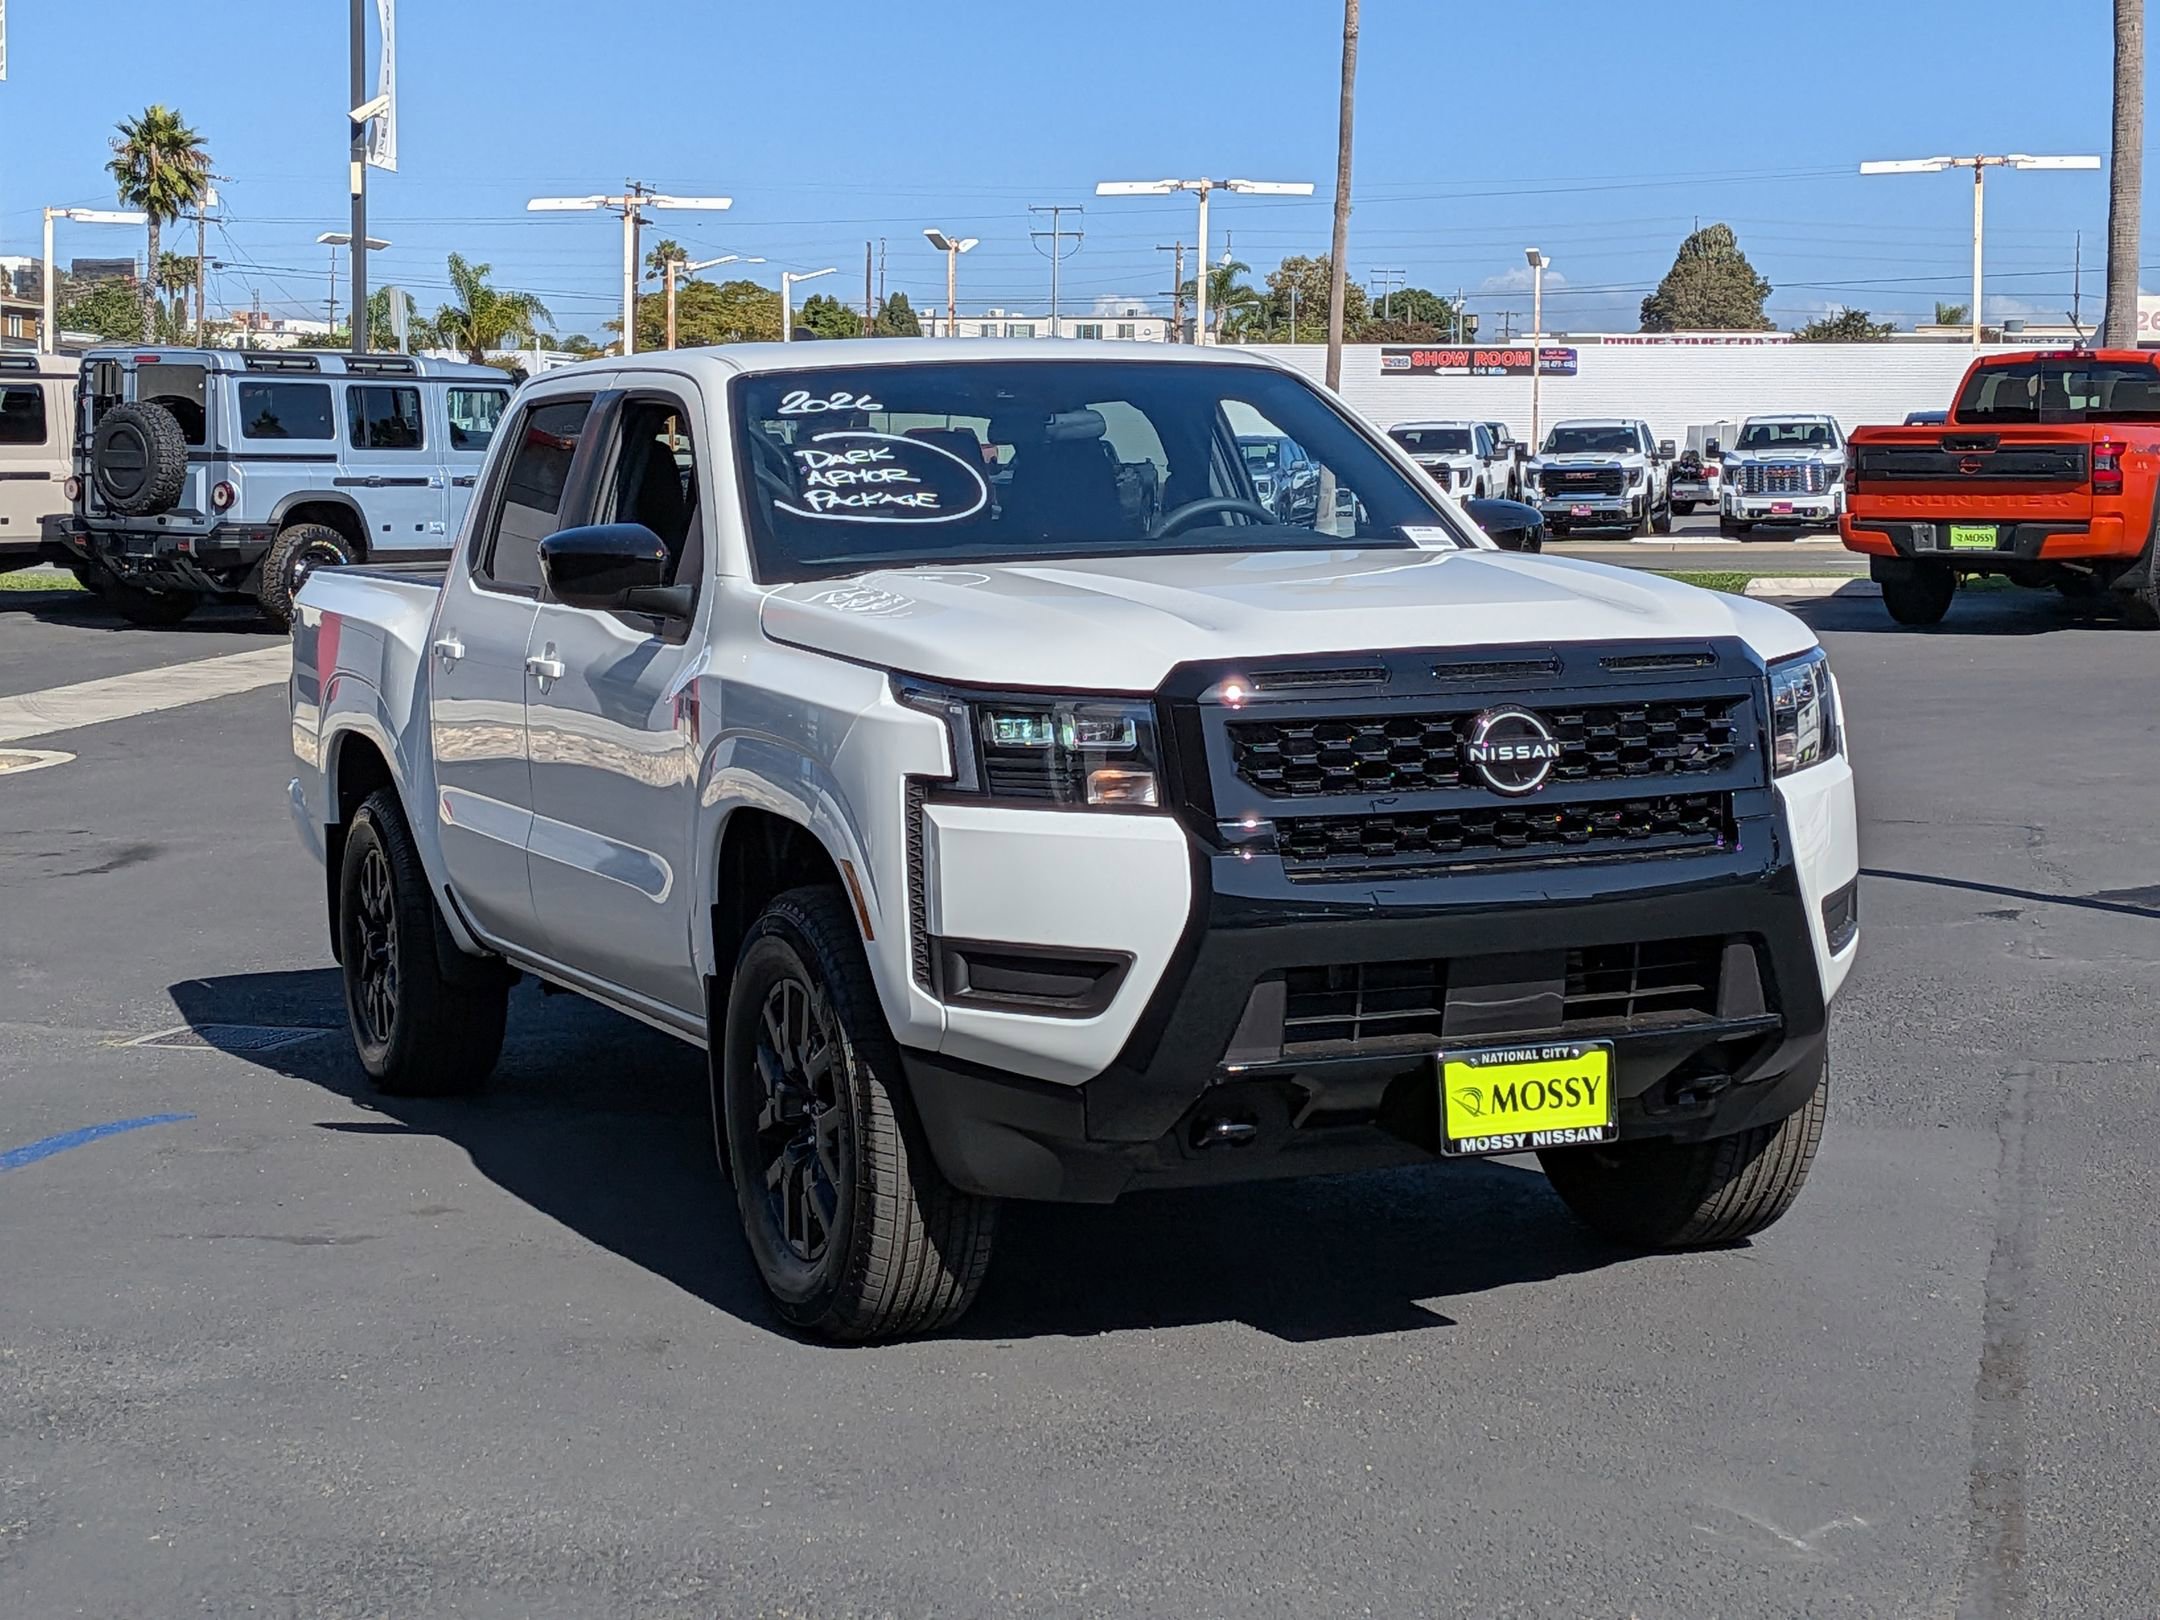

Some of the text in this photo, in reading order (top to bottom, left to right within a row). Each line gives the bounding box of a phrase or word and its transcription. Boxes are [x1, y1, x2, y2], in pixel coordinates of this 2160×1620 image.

[1412, 351, 1469, 366] SHOW
[1474, 351, 1531, 366] ROOM
[777, 391, 884, 414] 2026
[793, 447, 895, 468] DARK
[807, 469, 921, 487] ARMOR
[803, 489, 941, 512] PACKAGE
[1879, 495, 2071, 507] FRONTIER
[1963, 533, 1994, 543] MOSSY
[1469, 743, 1560, 761] NISSAN
[1481, 1047, 1570, 1064] NATIONAL CITY
[1491, 1075, 1601, 1115] MOSSY
[1460, 1126, 1604, 1153] MOSSY NISSAN
